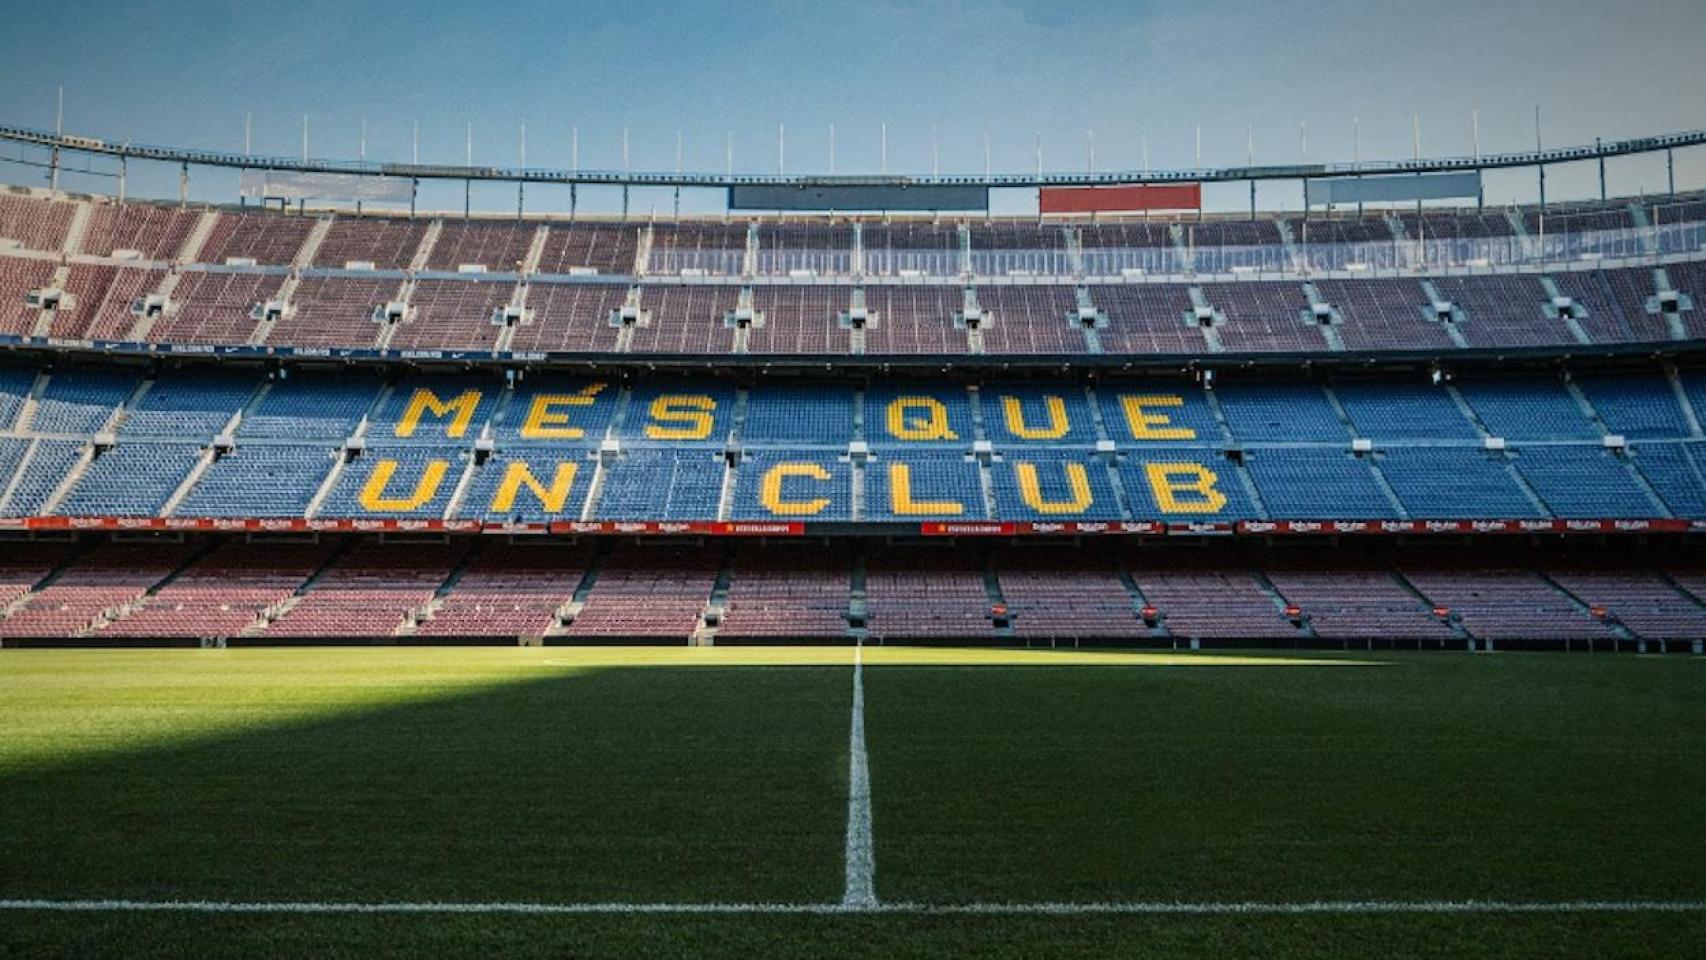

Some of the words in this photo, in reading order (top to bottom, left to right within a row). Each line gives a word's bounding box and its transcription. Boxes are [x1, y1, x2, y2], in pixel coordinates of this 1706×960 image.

[395, 383, 717, 439] MÉS
[886, 396, 1196, 440] QUE
[358, 460, 578, 512] UN
[760, 463, 1227, 515] CLUB
